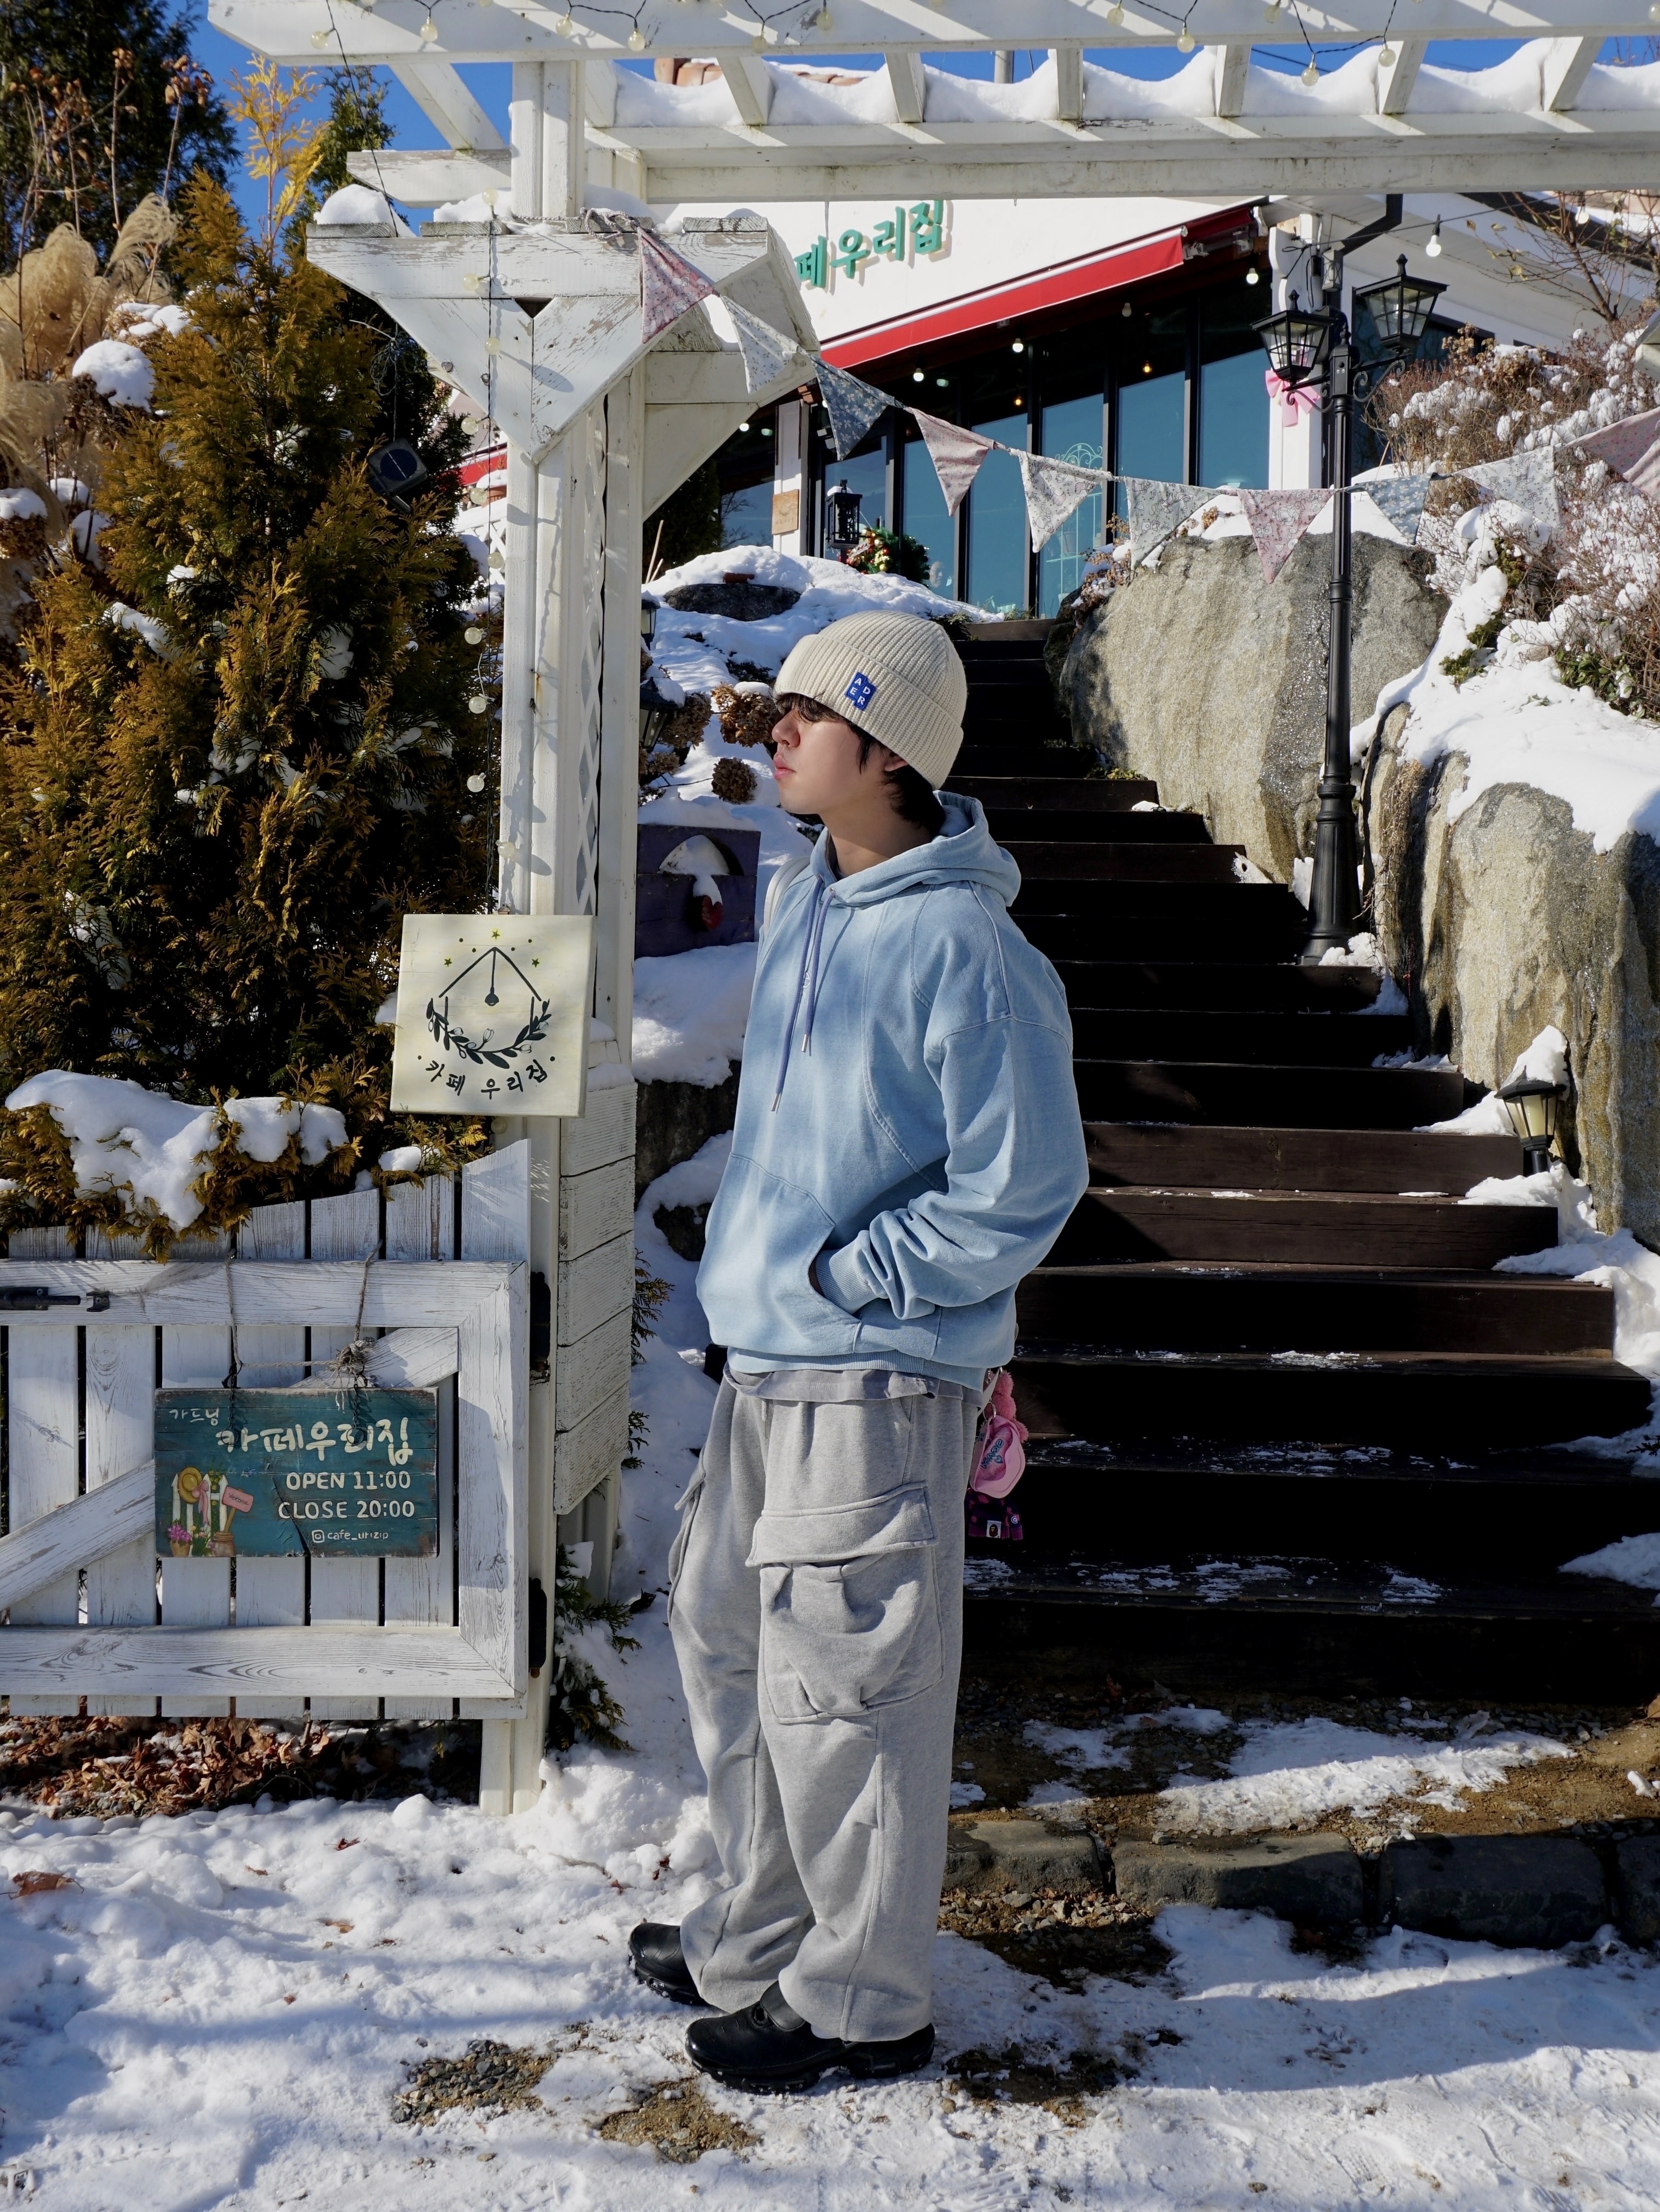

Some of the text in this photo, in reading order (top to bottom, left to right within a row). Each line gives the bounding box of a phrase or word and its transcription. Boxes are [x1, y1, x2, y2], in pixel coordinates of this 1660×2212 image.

[169, 1408, 219, 1426] 가드닝
[216, 1417, 413, 1467] 카페우리집
[286, 1471, 411, 1490] OPEN 11:00
[228, 1493, 249, 1506] Welcome
[278, 1500, 414, 1520] CLOSE 20:00
